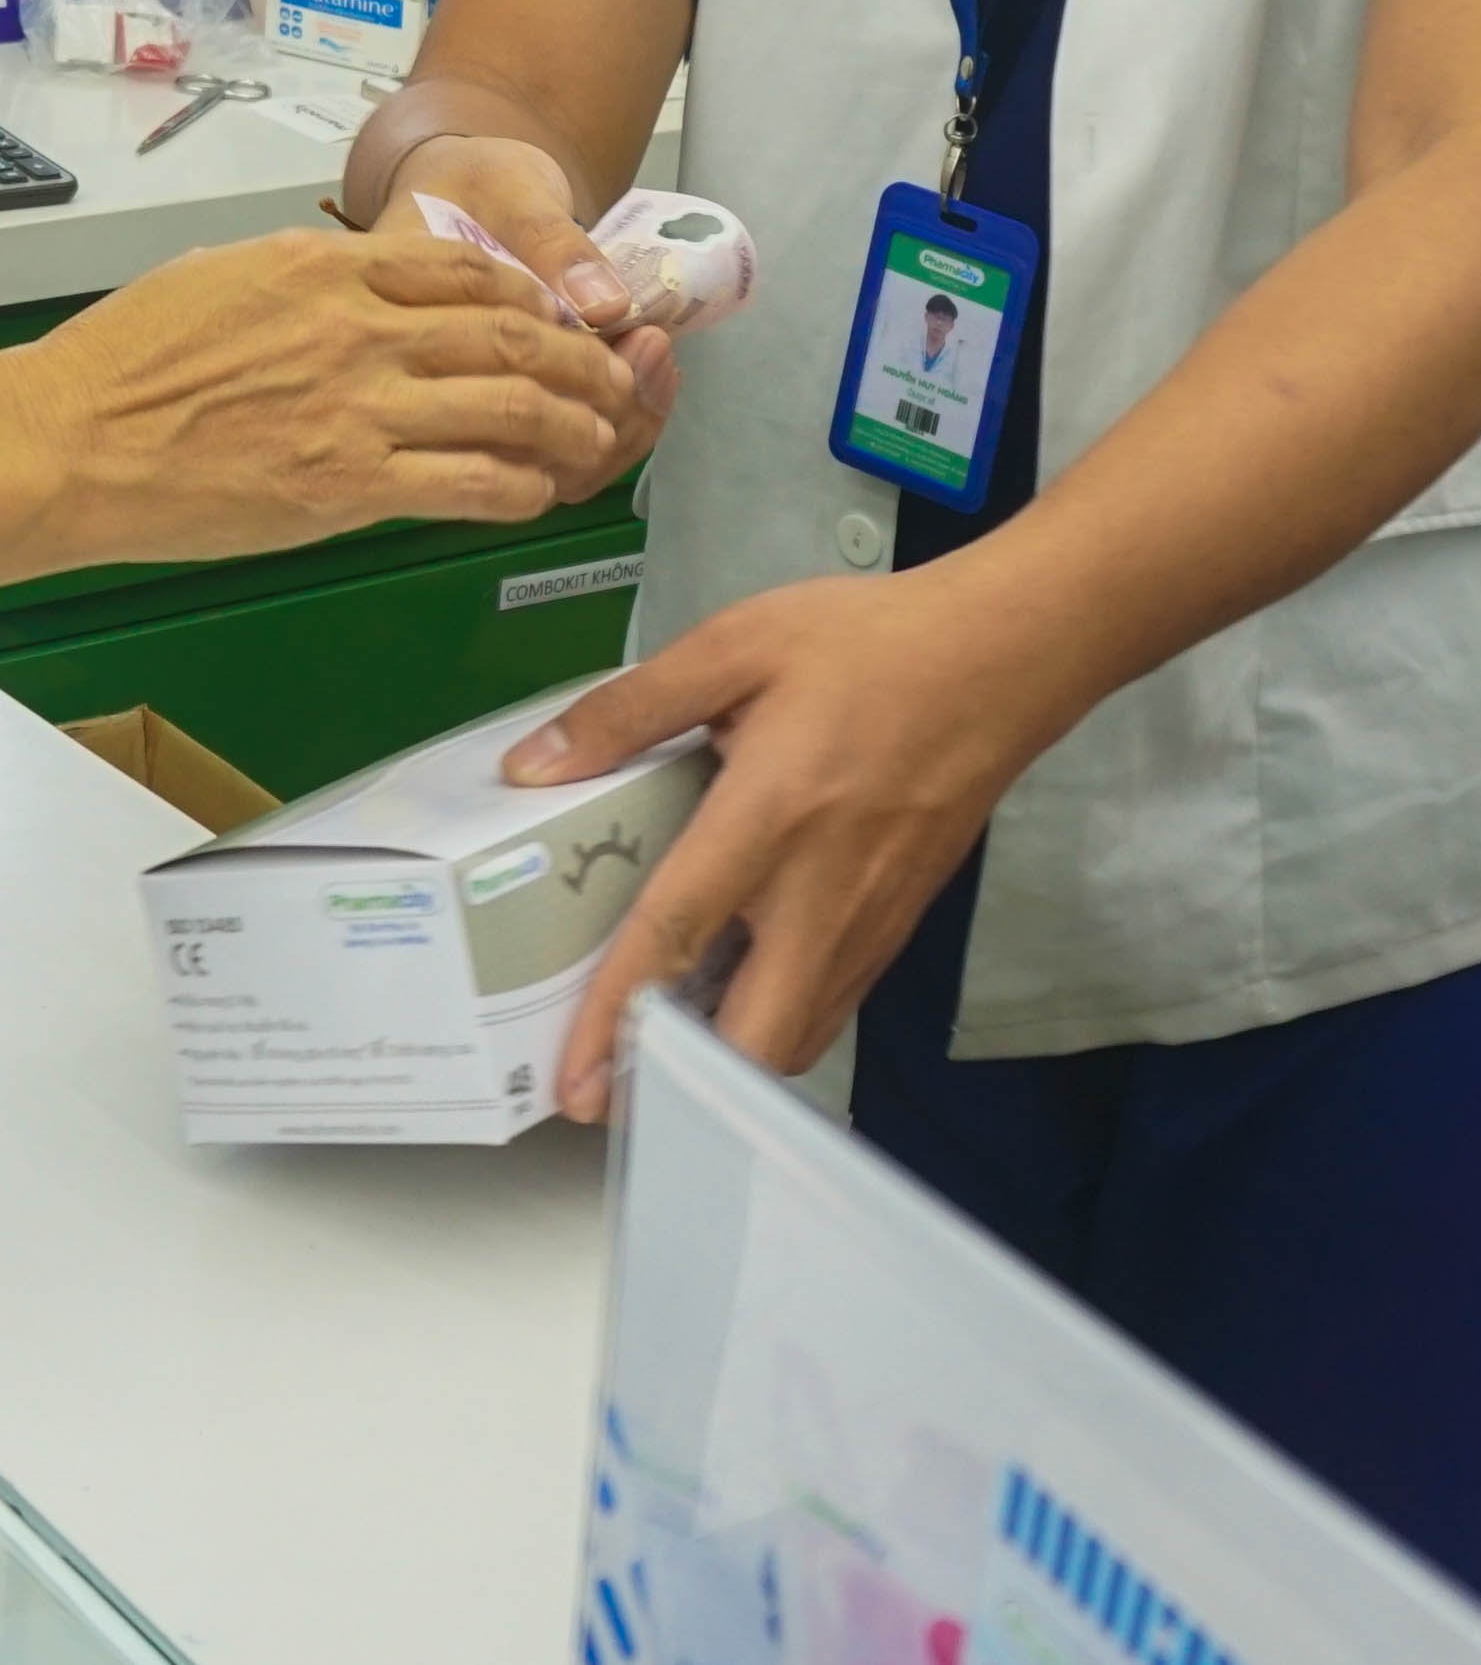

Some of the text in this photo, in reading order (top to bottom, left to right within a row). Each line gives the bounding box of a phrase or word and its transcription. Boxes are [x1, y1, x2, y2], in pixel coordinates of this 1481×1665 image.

[923, 254, 980, 284] Pharmacity
[506, 561, 644, 602] COMBOKIT KHÔNG
[170, 942, 210, 977] CE
